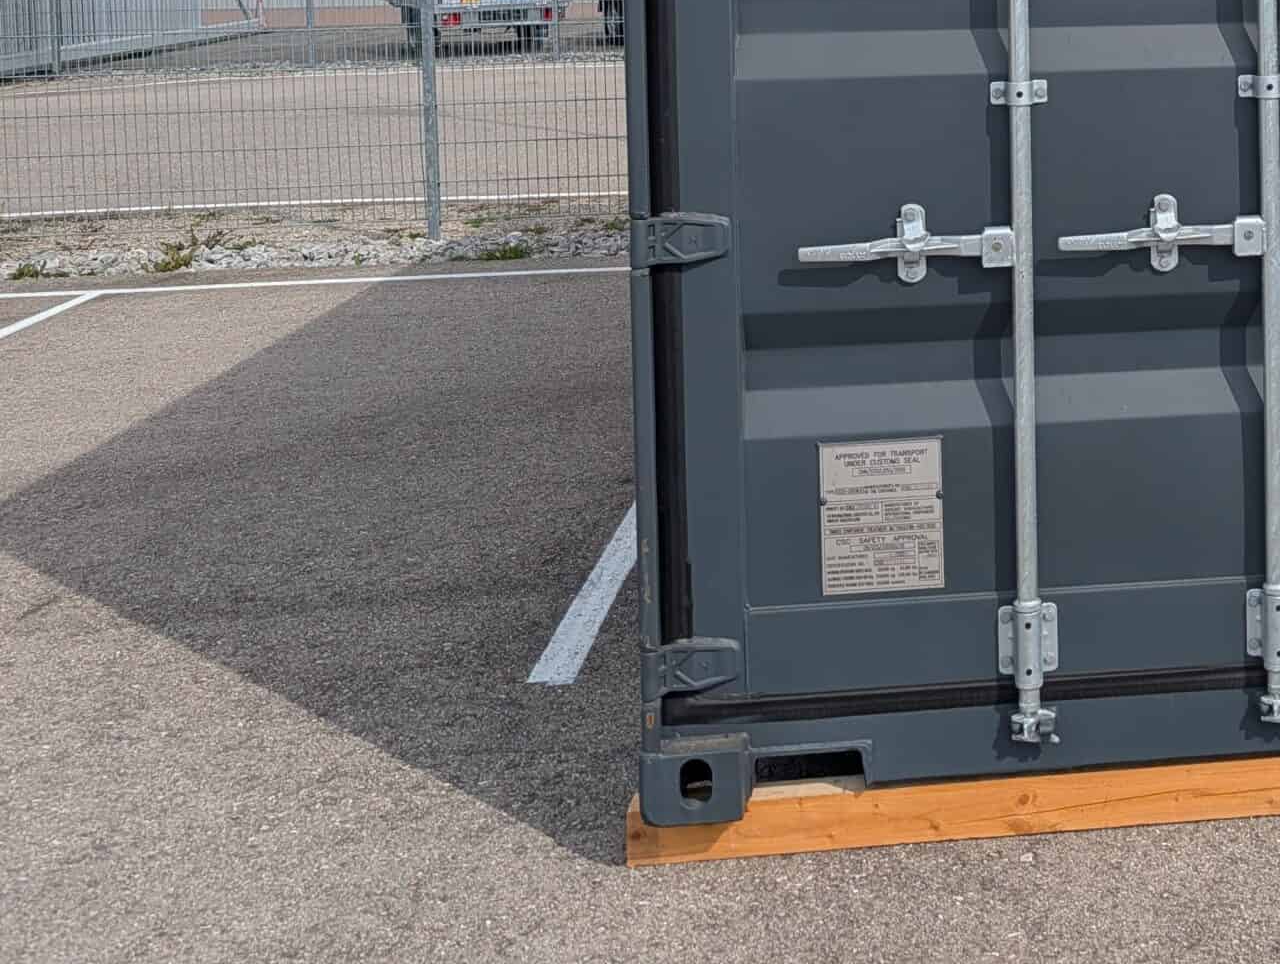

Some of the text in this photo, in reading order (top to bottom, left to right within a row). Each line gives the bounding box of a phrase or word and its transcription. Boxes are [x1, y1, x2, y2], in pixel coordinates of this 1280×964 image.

[834, 448, 928, 461] APPROVED FOR TRANSPORT
[843, 459, 866, 468] UNDER
[869, 458, 900, 467] CUSTOMS
[859, 536, 885, 545] SAFETY
[893, 533, 928, 542] APPROVAL
